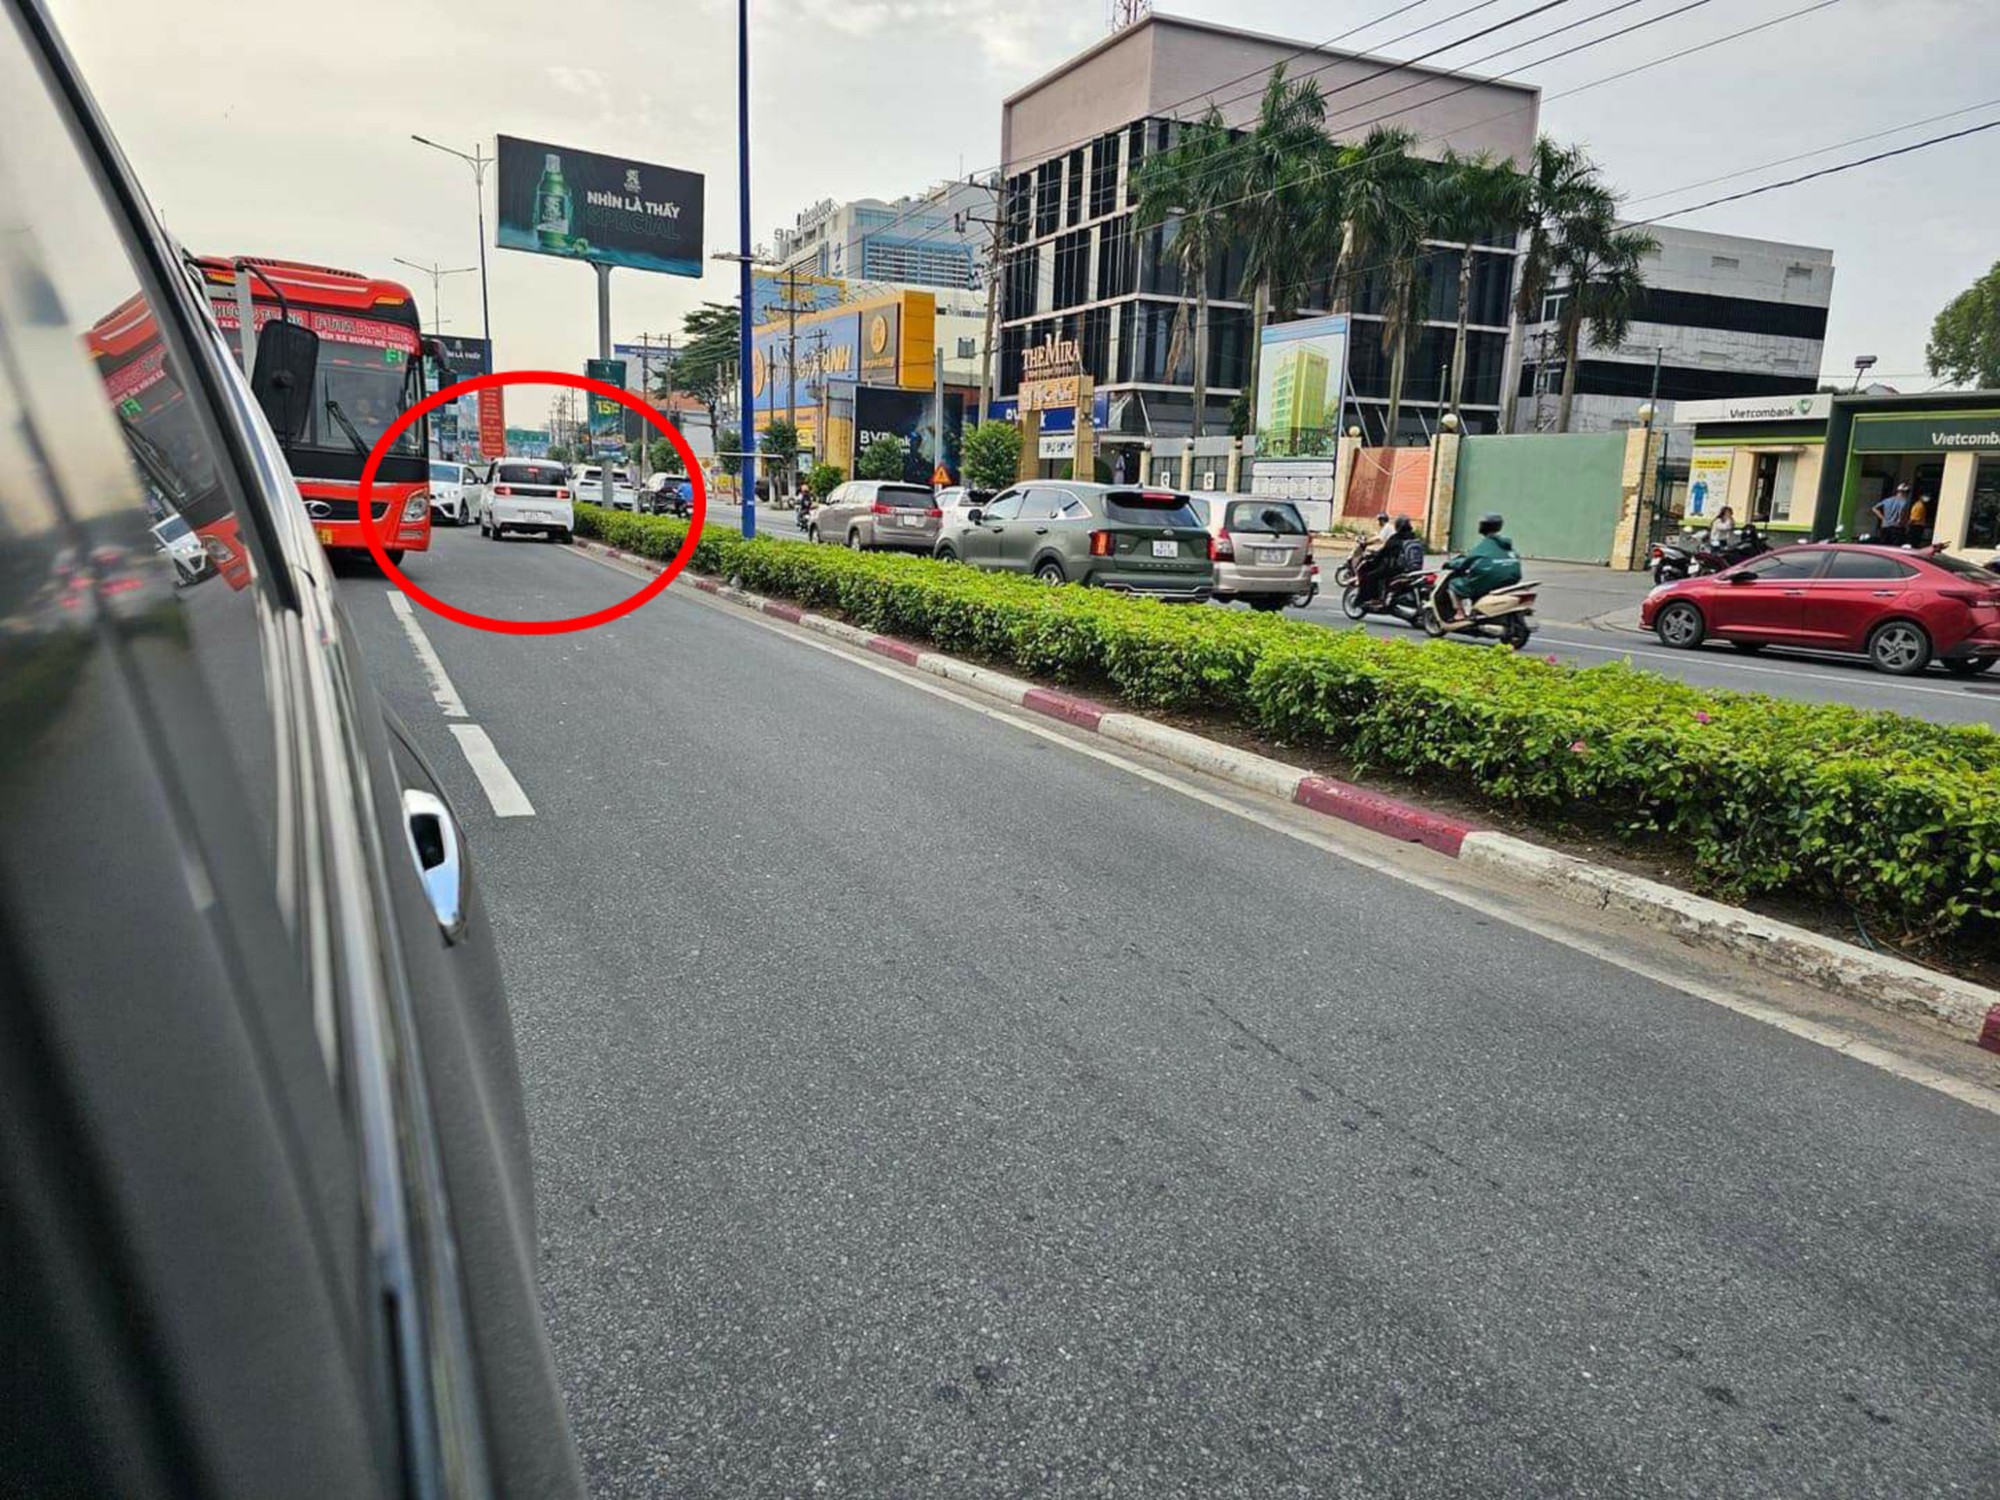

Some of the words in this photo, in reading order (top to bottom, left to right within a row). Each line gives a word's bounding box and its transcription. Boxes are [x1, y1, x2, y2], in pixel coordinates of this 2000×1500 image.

[587, 190, 622, 210] NHÌN
[624, 196, 643, 214] LÀ
[645, 201, 680, 219] THẤY
[1730, 408, 1796, 419] Vietcombank
[1932, 431, 2000, 446] Vietcomb
